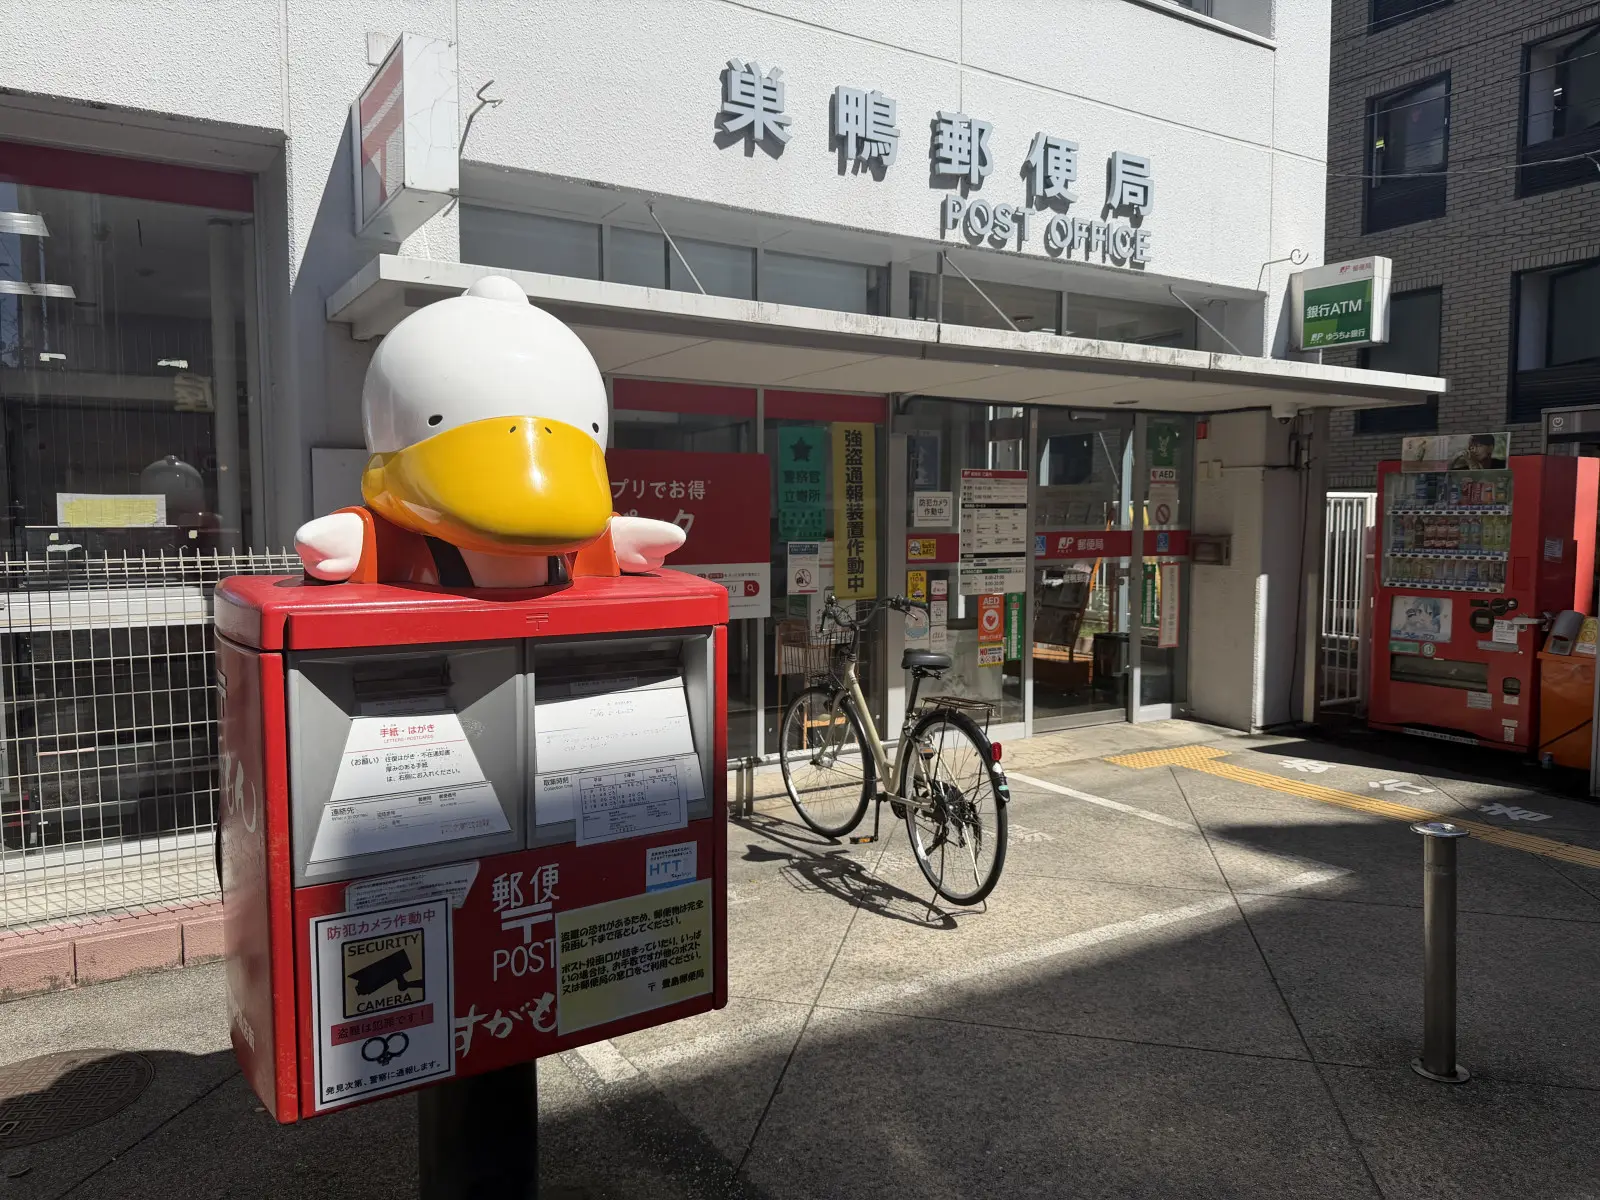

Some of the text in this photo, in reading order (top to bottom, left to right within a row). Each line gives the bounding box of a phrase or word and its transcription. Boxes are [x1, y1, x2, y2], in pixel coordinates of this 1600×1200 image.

[721, 56, 1156, 217] 巣鴨郵便局
[944, 193, 1153, 263] POST OFFICE
[1306, 299, 1362, 319] 銀行ATM
[1325, 328, 1366, 341] ゆうちょ銀行
[1159, 470, 1174, 479] AED
[611, 479, 706, 500] プリでお得
[844, 429, 865, 593] 強盗通報装置作動中
[919, 498, 948, 508] 防犯カメラ
[924, 507, 944, 516] 作動中
[1077, 538, 1104, 551] 郵便局
[983, 596, 1000, 605] AED
[380, 724, 436, 738] 手紙・はがき
[331, 807, 355, 817] 連絡先
[649, 859, 682, 877] HTT
[492, 862, 560, 913] 郵便
[327, 908, 436, 941] 防犯カメラ作動中
[560, 900, 704, 943] 盗難の恐れがあるため、郵便物は完全
[347, 933, 420, 957] SECURITY
[493, 937, 557, 983] POST
[356, 992, 412, 1013] CAMERA
[454, 991, 557, 1059] すがも
[325, 1060, 442, 1096] 発見次第、警察に通報します。
